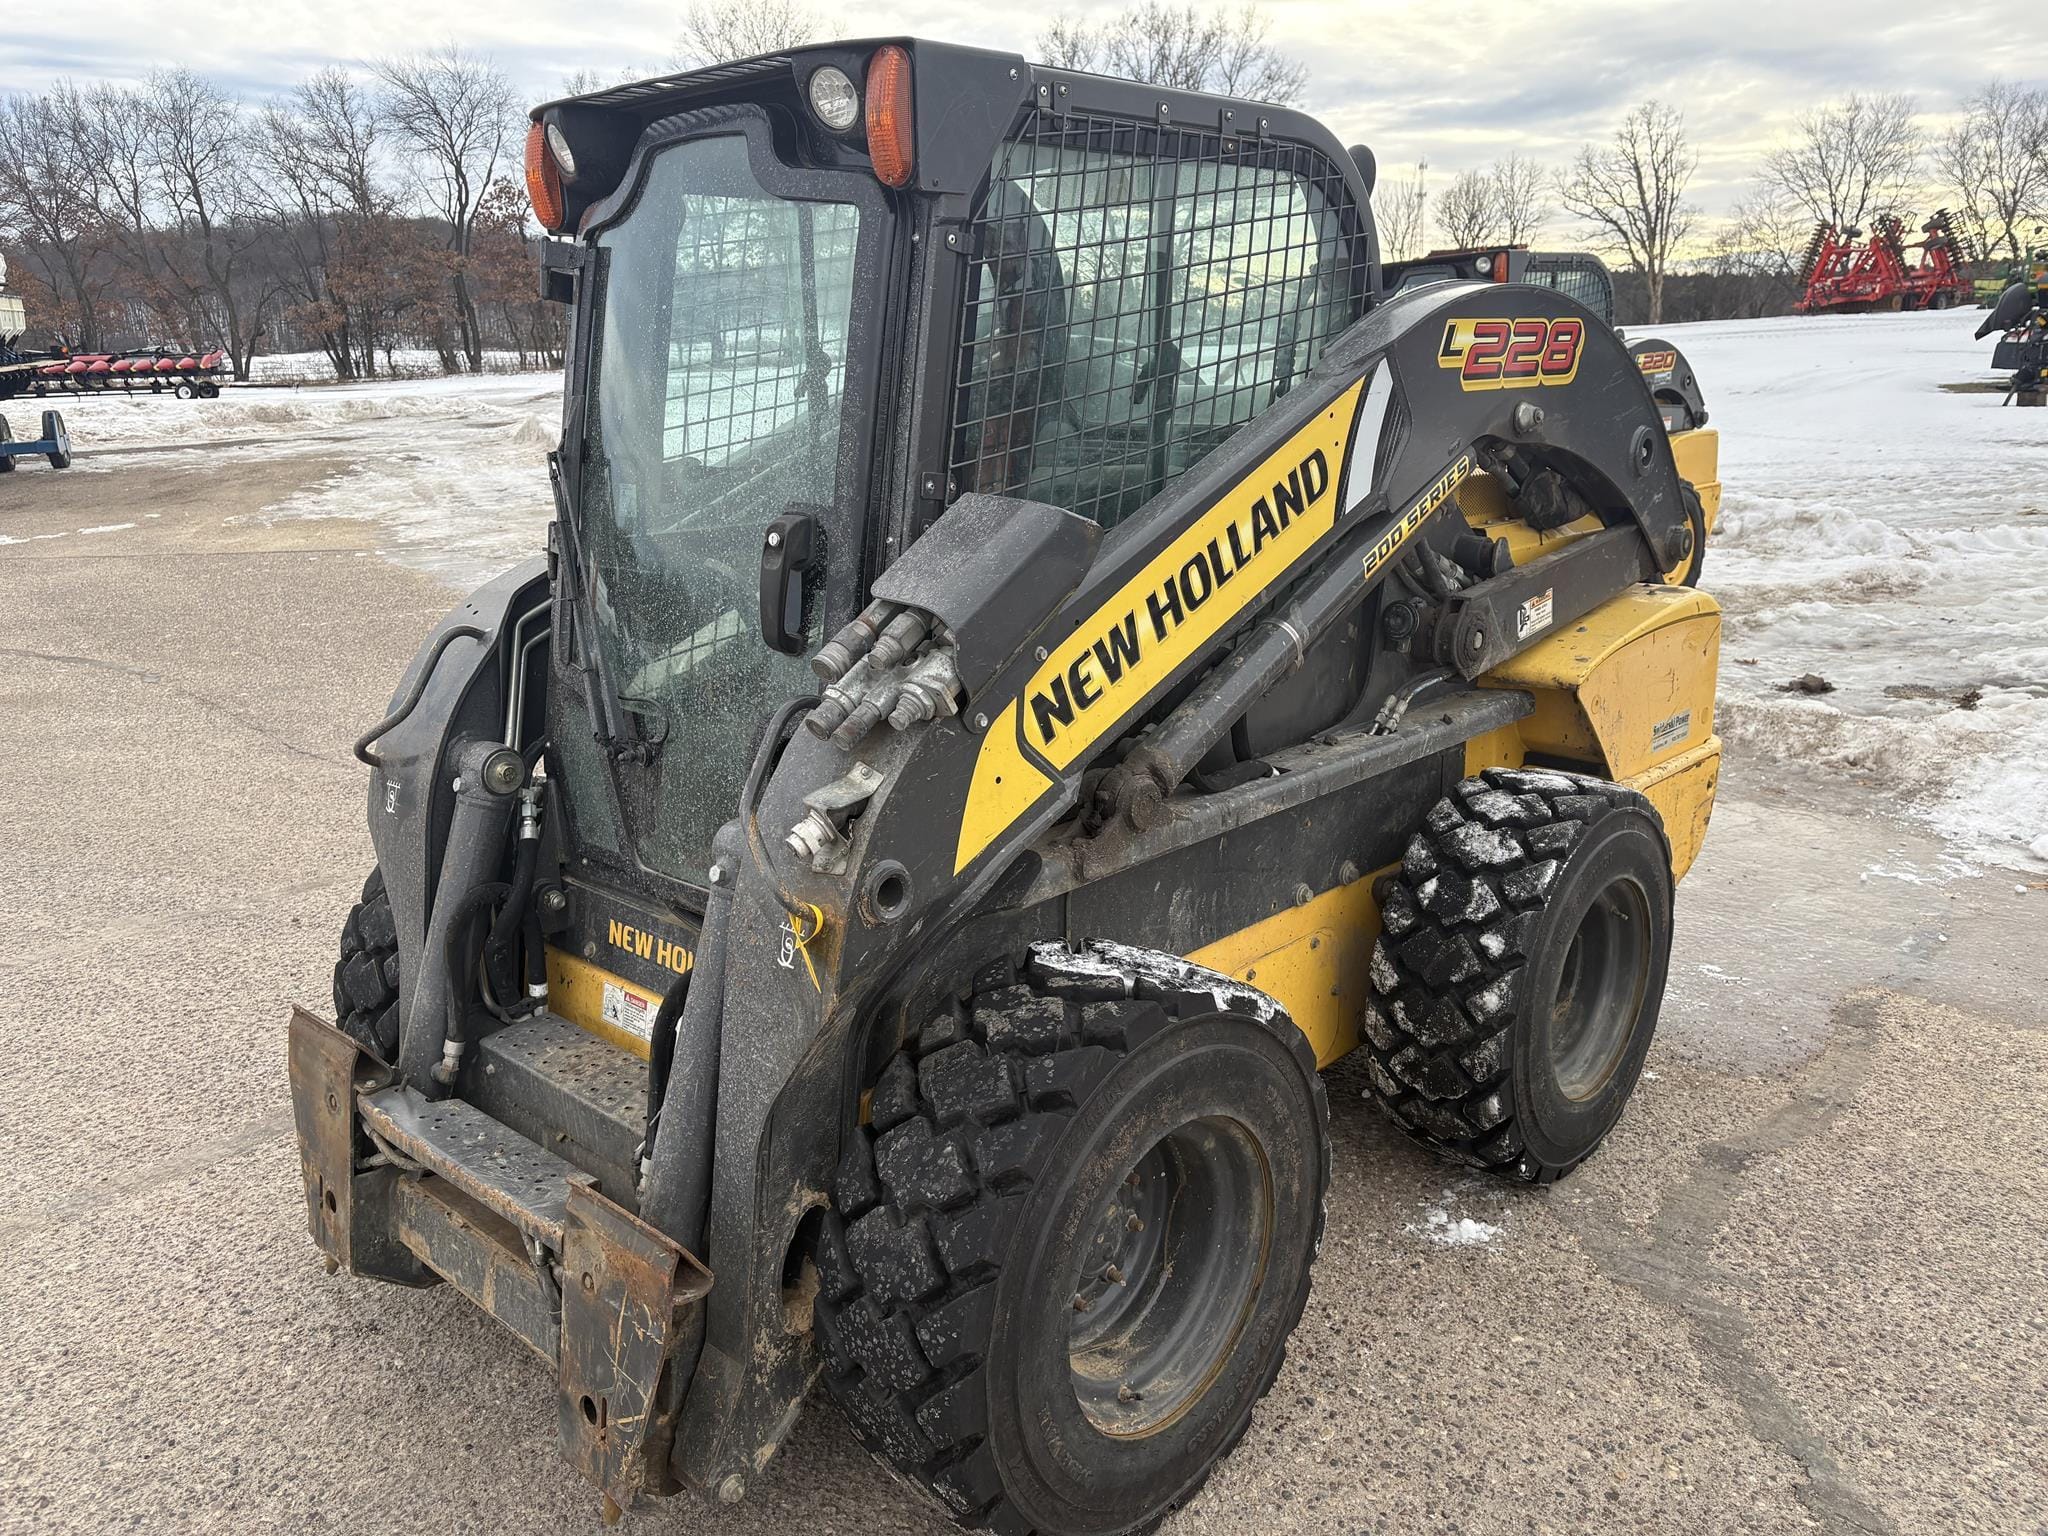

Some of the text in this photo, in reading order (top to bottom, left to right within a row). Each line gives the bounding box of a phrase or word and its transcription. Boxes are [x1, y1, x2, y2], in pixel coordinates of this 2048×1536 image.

[1439, 319, 1584, 387] L228
[1364, 456, 1470, 577] 200 SERIES
[1029, 447, 1329, 745] NEW HOLLAND
[608, 918, 654, 960] NEW
